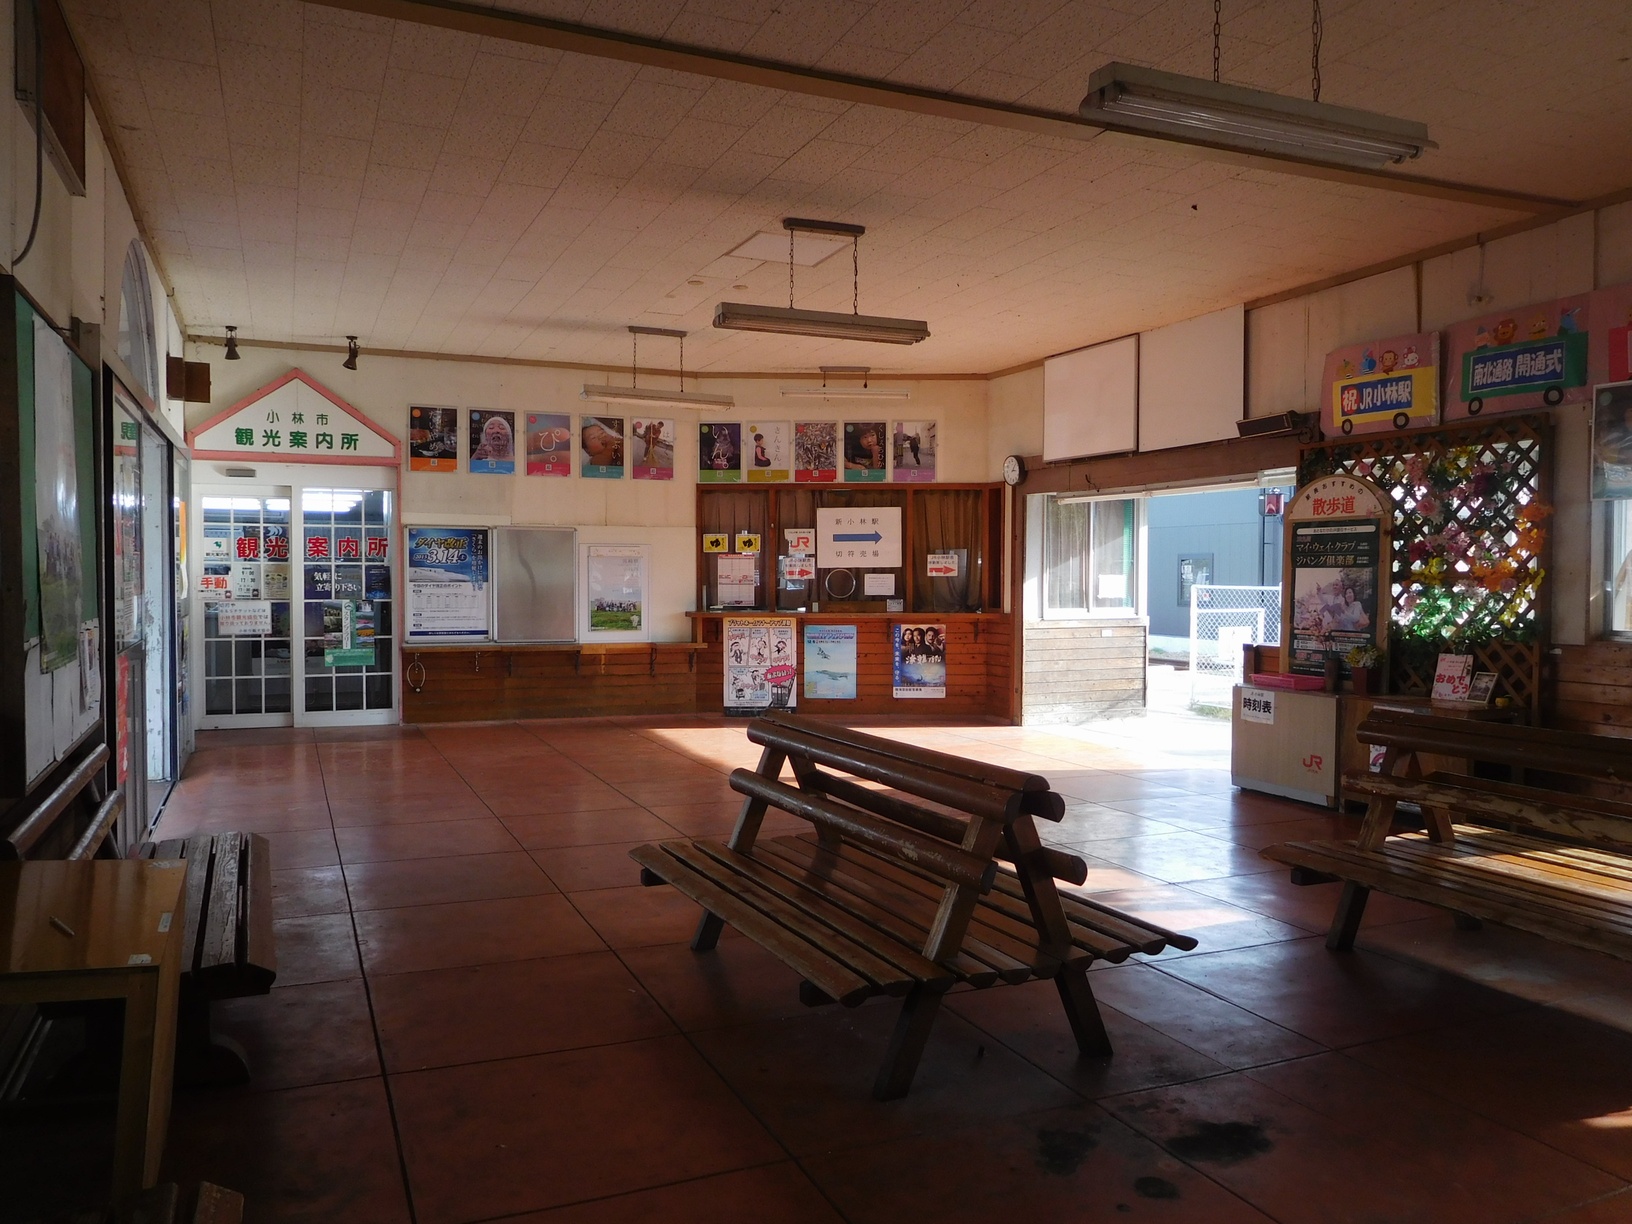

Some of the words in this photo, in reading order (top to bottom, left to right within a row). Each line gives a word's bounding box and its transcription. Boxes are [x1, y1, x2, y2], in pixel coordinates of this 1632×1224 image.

[1473, 358, 1513, 386] 南北通路
[1514, 348, 1562, 378] 開通式
[1342, 388, 1358, 411] 祝
[1360, 380, 1411, 410] JR小林駅
[266, 410, 329, 426] 小林市
[235, 427, 359, 451] 観光案内所
[1312, 495, 1355, 516] 散歩道
[835, 518, 880, 526] 新小林駅
[235, 536, 390, 559] 観光案内所
[413, 536, 469, 550] ダイヤ改正
[789, 536, 810, 549] JR
[426, 548, 461, 565] 3.14
[835, 550, 880, 558] 切符売場
[1295, 554, 1356, 567] ジパング倶楽部
[200, 576, 228, 589] 手動
[1435, 673, 1467, 686] おめで
[1451, 683, 1470, 695] とう
[1243, 697, 1273, 715] 時刻表
[1302, 754, 1323, 771] JR
